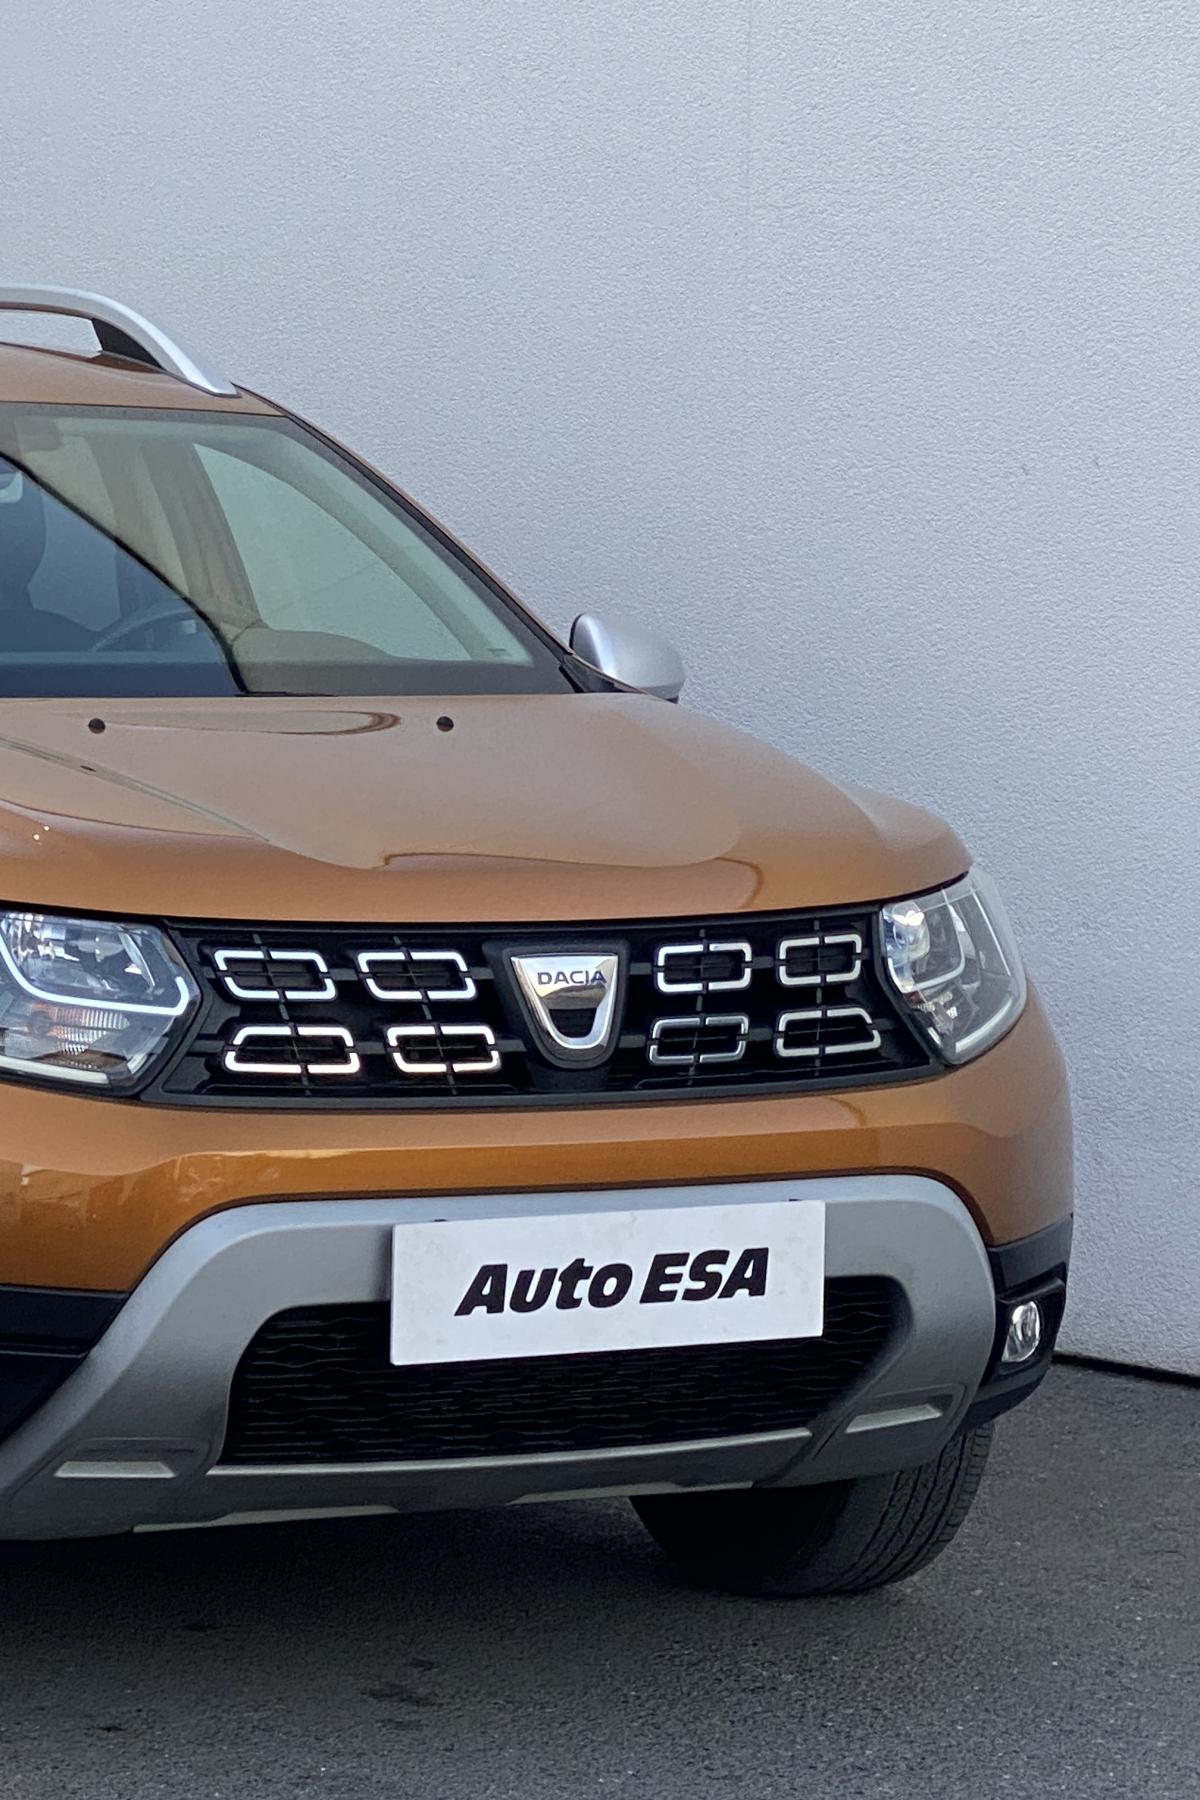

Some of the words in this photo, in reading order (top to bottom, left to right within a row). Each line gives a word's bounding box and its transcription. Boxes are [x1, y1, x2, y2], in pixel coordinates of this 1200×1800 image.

[537, 970, 608, 985] DACIA
[454, 1257, 633, 1317] Auto
[639, 1247, 769, 1304] ESA
